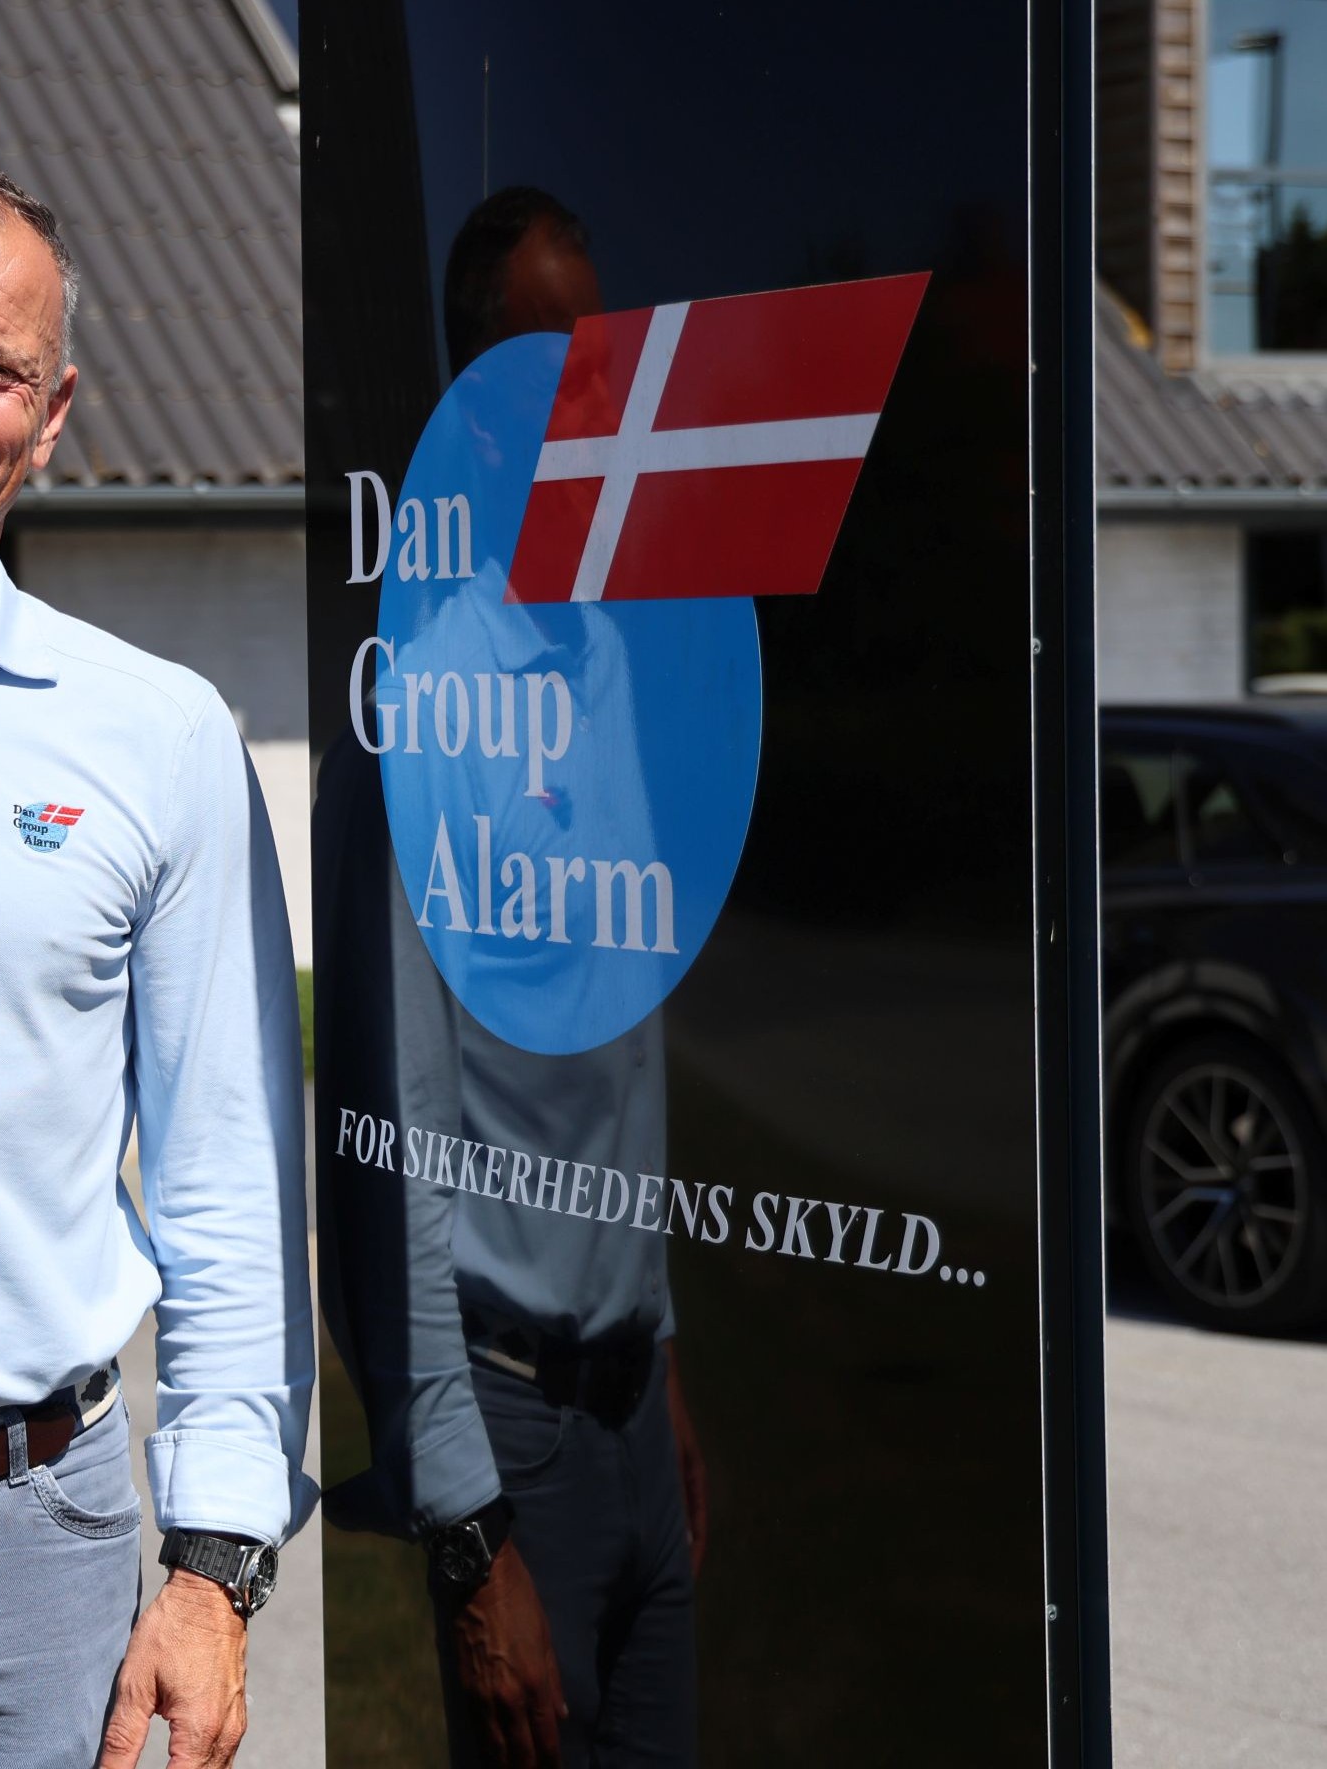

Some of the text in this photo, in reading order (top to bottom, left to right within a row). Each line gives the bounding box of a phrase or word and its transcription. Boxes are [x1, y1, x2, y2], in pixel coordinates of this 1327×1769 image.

[345, 470, 476, 585] Dan
[349, 636, 573, 798] Group
[13, 804, 35, 818] Dan
[13, 817, 48, 835] Group
[24, 834, 60, 849] Alarm
[416, 811, 679, 954] Alarm
[335, 1107, 986, 1287] FOR SIKKERHEDENS SKYLD...
